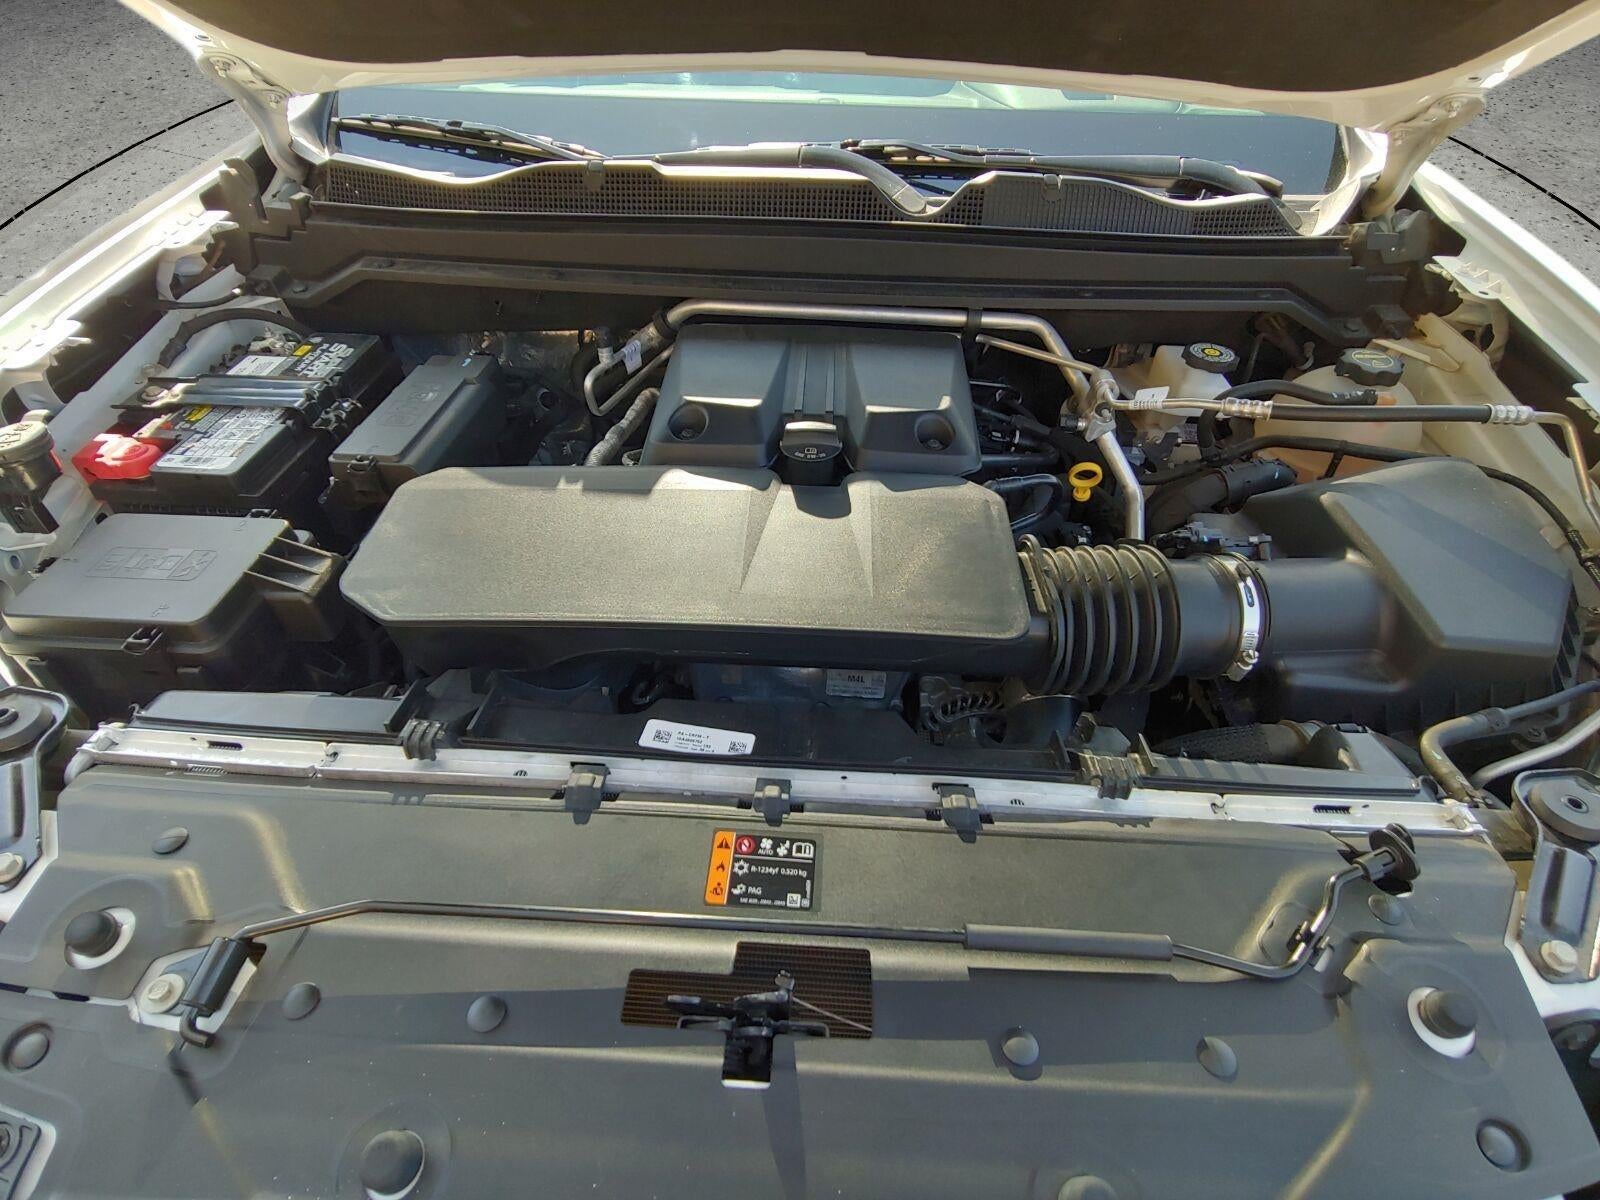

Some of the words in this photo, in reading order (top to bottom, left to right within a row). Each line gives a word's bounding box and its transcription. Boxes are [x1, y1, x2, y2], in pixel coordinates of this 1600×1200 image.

[848, 675, 865, 683] M4L
[758, 848, 774, 856] AUTO
[750, 865, 779, 876] R-1234yf
[780, 867, 798, 877] 0.520
[798, 869, 807, 878] kg
[747, 886, 762, 895] PAG
